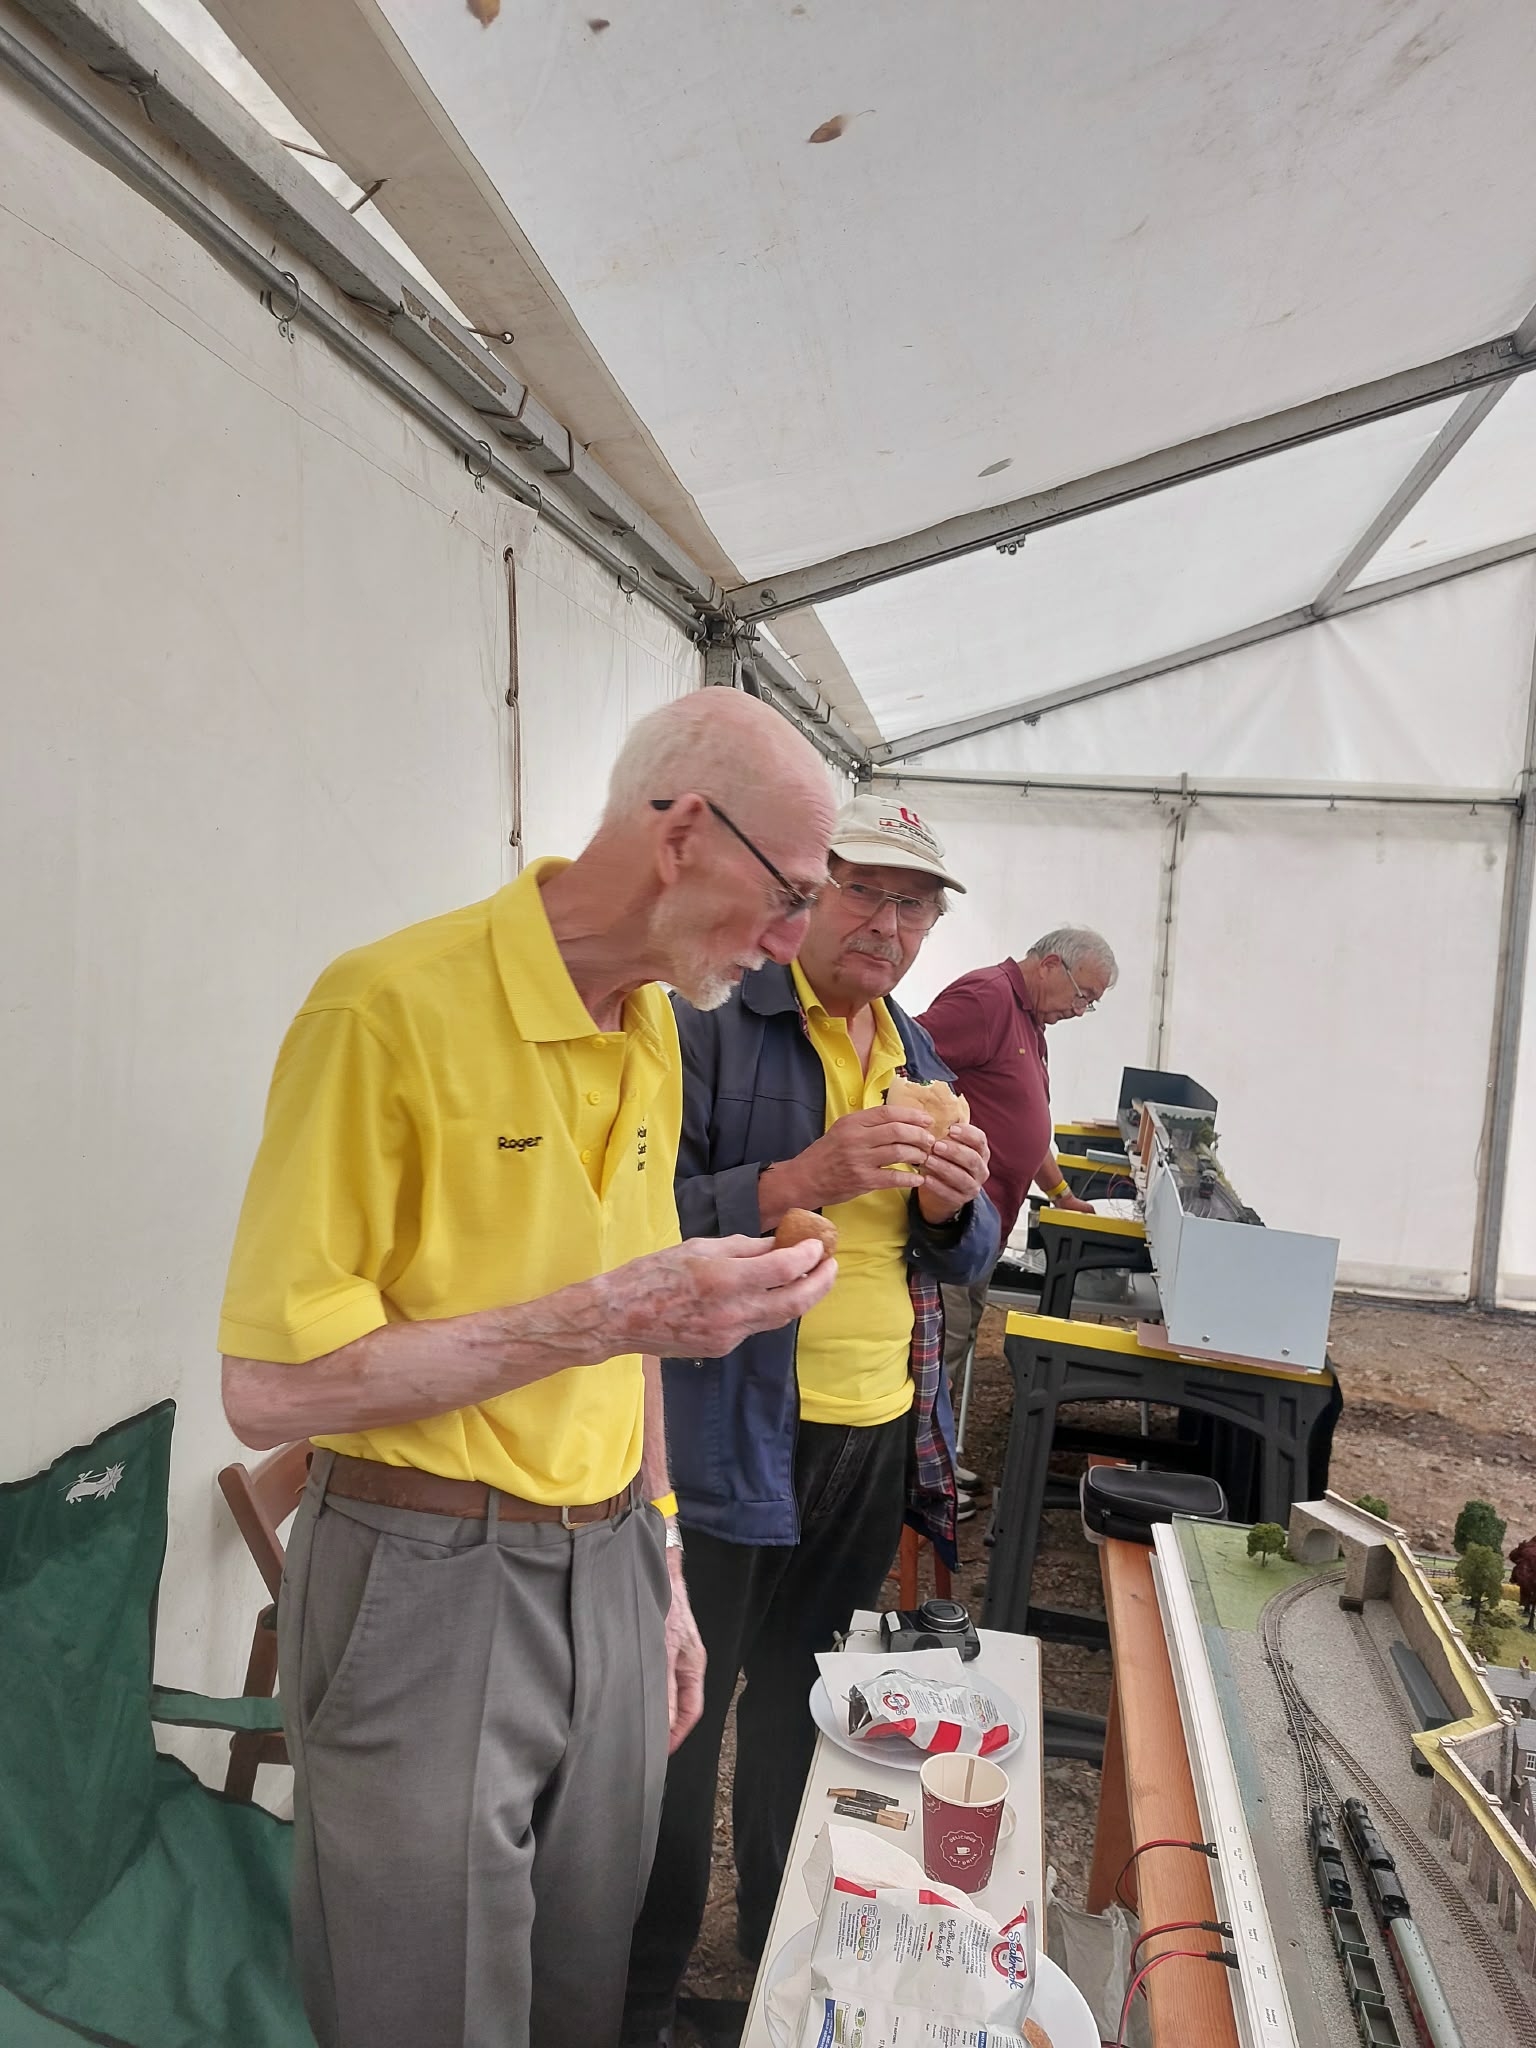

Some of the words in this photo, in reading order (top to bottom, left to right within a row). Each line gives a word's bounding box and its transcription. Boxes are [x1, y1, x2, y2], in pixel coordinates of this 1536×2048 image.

[498, 1136, 543, 1152] Roger
[948, 1834, 977, 1844] DELICIOUS
[945, 1919, 957, 1954] Brilliant
[935, 1935, 947, 1961] bagful
[942, 1955, 955, 1968] by
[1006, 1931, 1024, 1990] Seabrook
